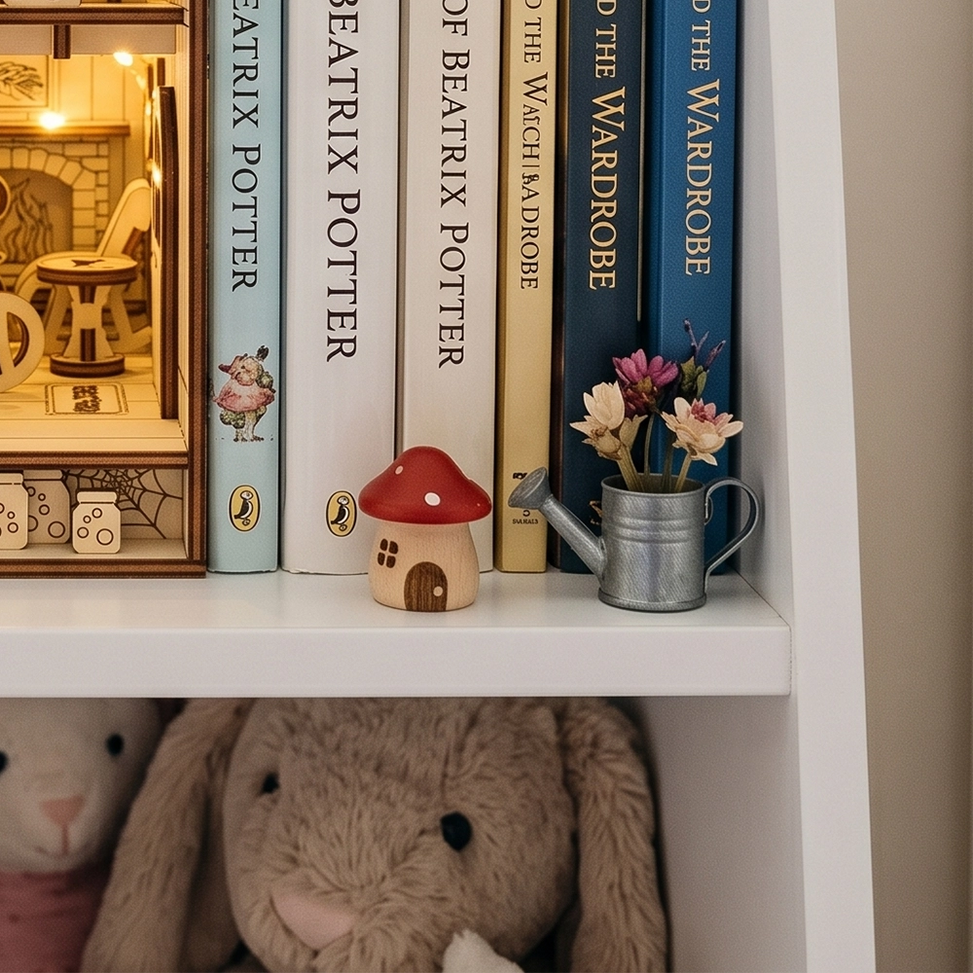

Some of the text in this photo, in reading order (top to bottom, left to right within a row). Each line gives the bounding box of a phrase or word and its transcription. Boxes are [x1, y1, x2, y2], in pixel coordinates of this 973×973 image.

[523, 16, 542, 64] THE
[593, 23, 617, 79] THE
[690, 19, 712, 72] THE
[440, 48, 471, 209] BEATRIX
[588, 85, 627, 291] WARDROBE
[684, 78, 721, 277] WARDROBE
[231, 143, 262, 293] POTTER
[326, 188, 361, 364] POTTER
[438, 222, 470, 370] POTTER
